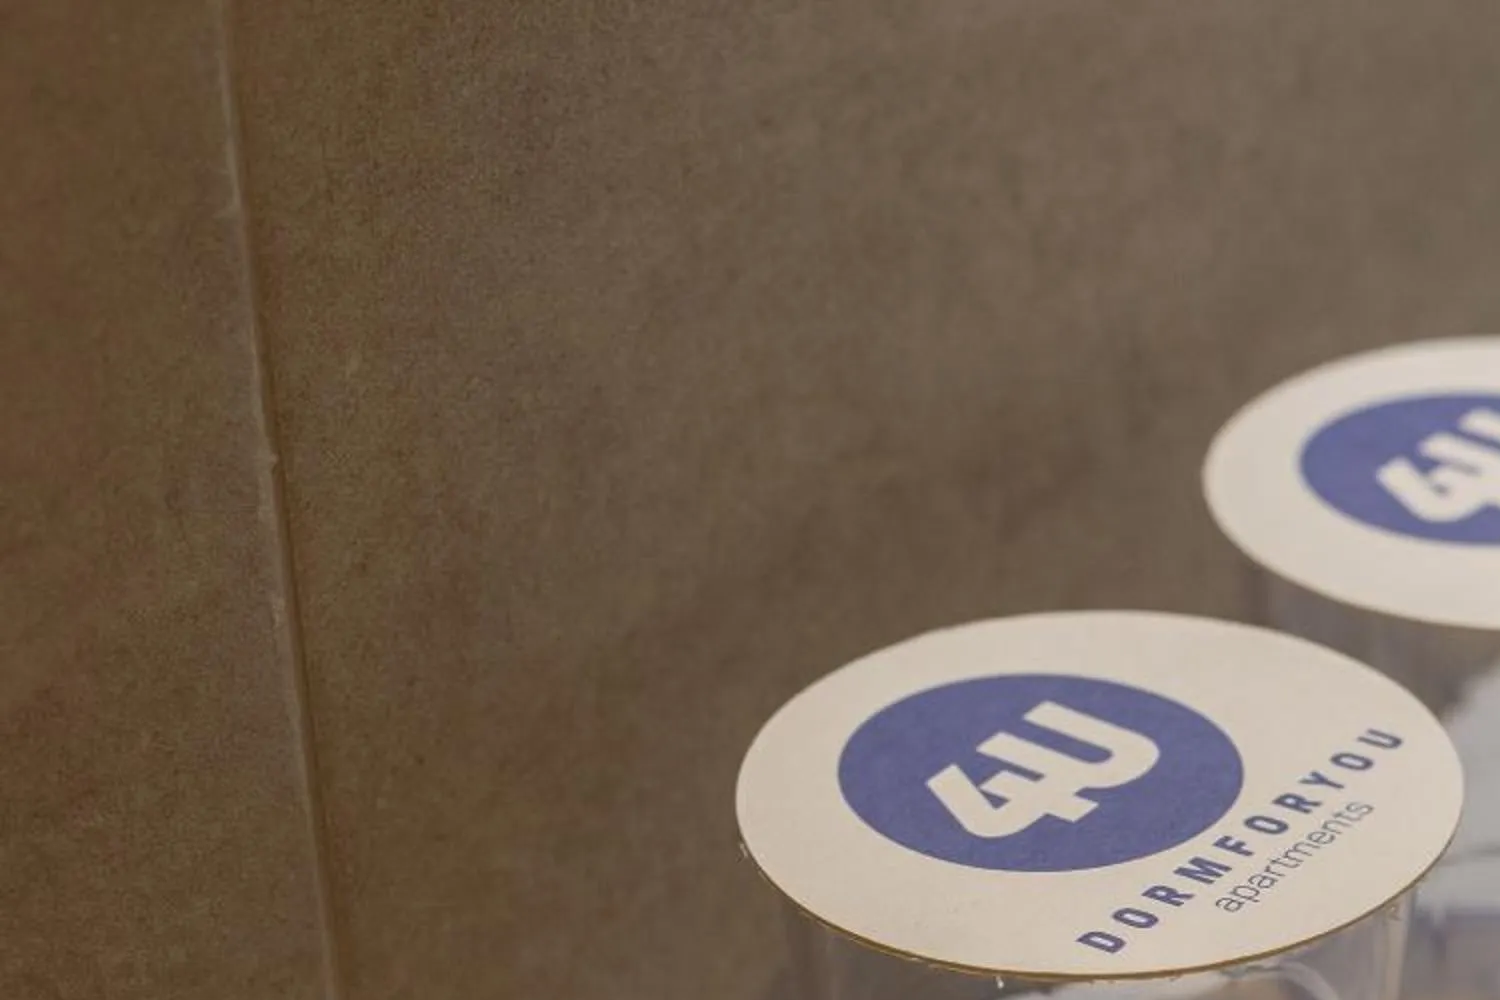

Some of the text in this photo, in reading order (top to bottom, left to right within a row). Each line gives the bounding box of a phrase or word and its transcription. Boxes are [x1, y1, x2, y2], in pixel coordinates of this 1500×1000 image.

[926, 701, 1161, 838] 4U
[1077, 728, 1404, 954] DORMFORYOU
[1214, 800, 1375, 913] apartments
